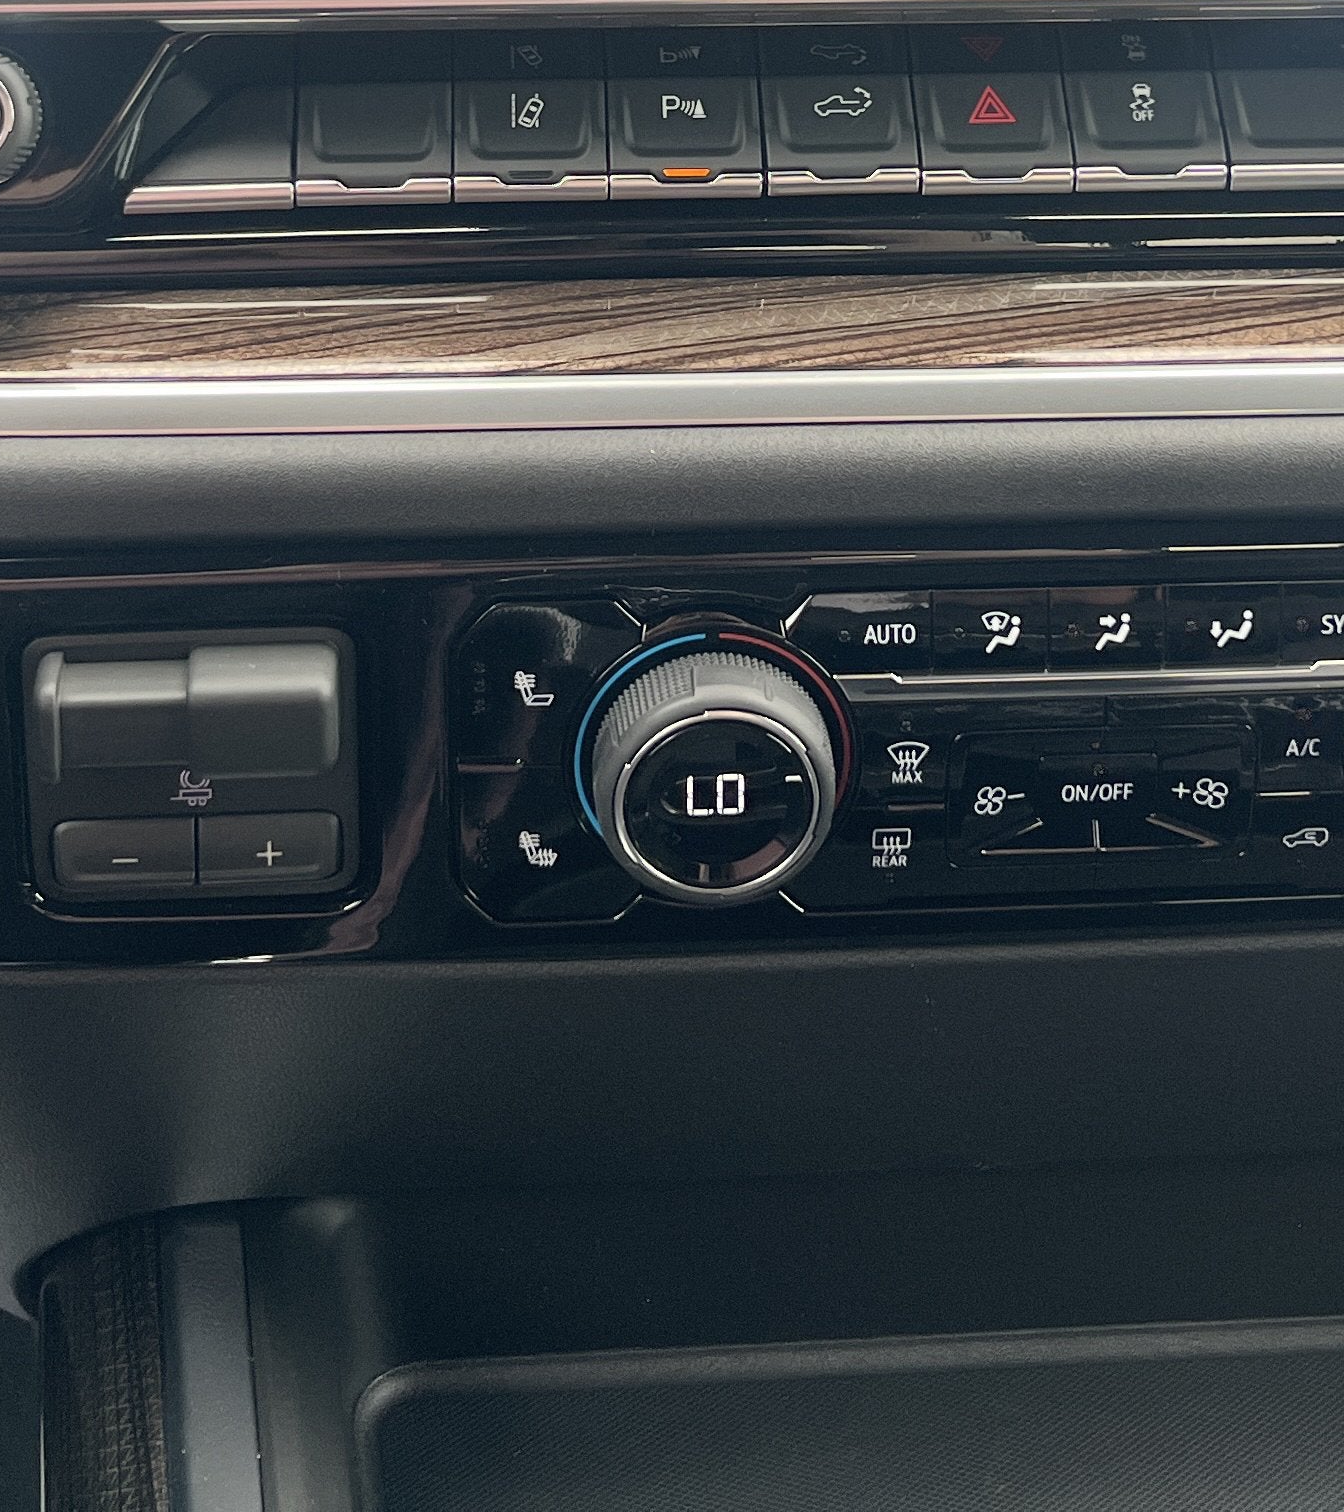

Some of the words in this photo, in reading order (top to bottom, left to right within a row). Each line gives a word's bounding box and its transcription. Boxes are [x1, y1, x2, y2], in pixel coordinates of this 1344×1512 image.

[1131, 109, 1155, 122] OFF
[863, 623, 917, 646] AUTO
[1286, 738, 1321, 758] A/C
[891, 769, 923, 785] MAX
[1061, 782, 1134, 803] ON/OFF
[871, 854, 908, 869] REAR
